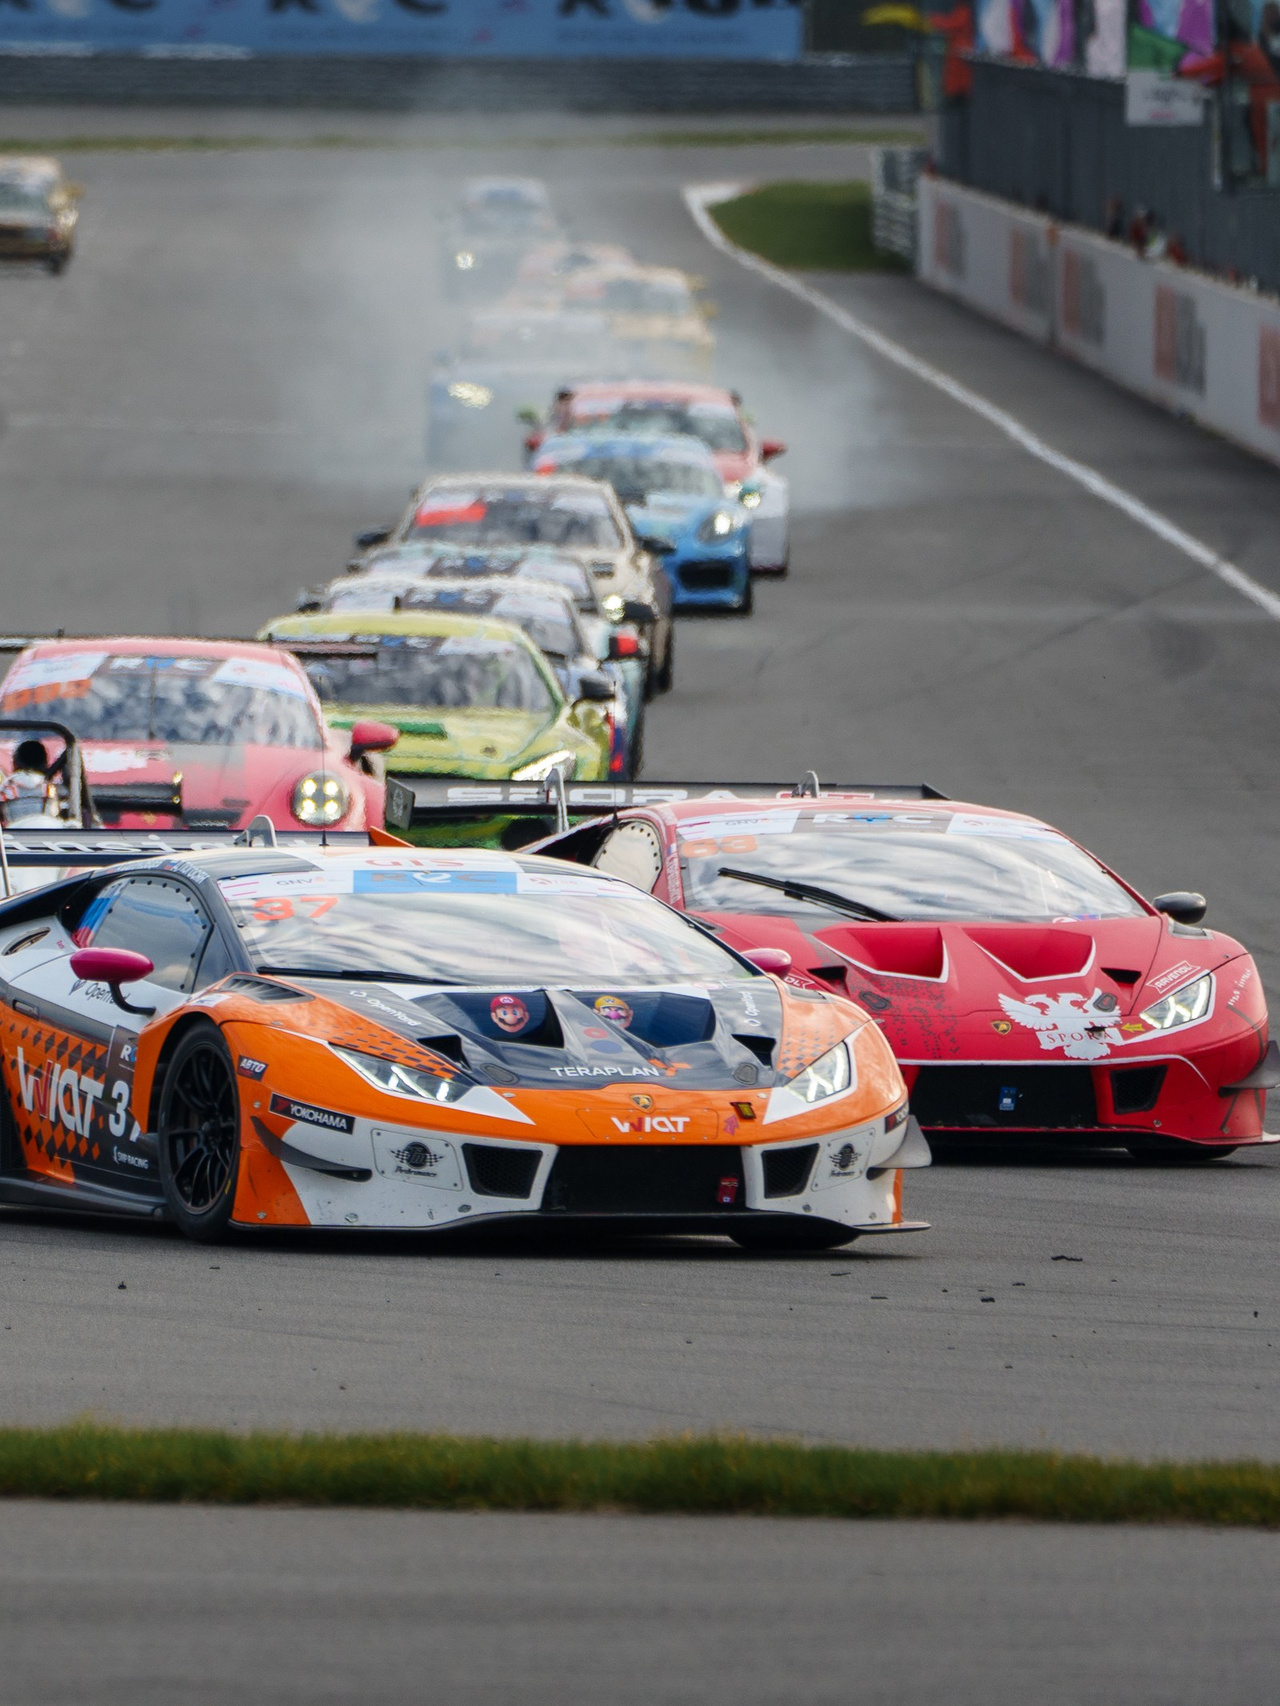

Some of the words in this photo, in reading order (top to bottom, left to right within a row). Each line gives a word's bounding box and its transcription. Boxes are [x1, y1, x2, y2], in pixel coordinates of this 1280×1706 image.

[681, 834, 758, 858] 63
[253, 896, 339, 921] 37
[1154, 964, 1193, 989] RAVENOL
[1046, 1027, 1114, 1045] SPORA
[549, 1066, 660, 1077] TERAPLAN
[289, 1103, 348, 1130] YOKOHAMA
